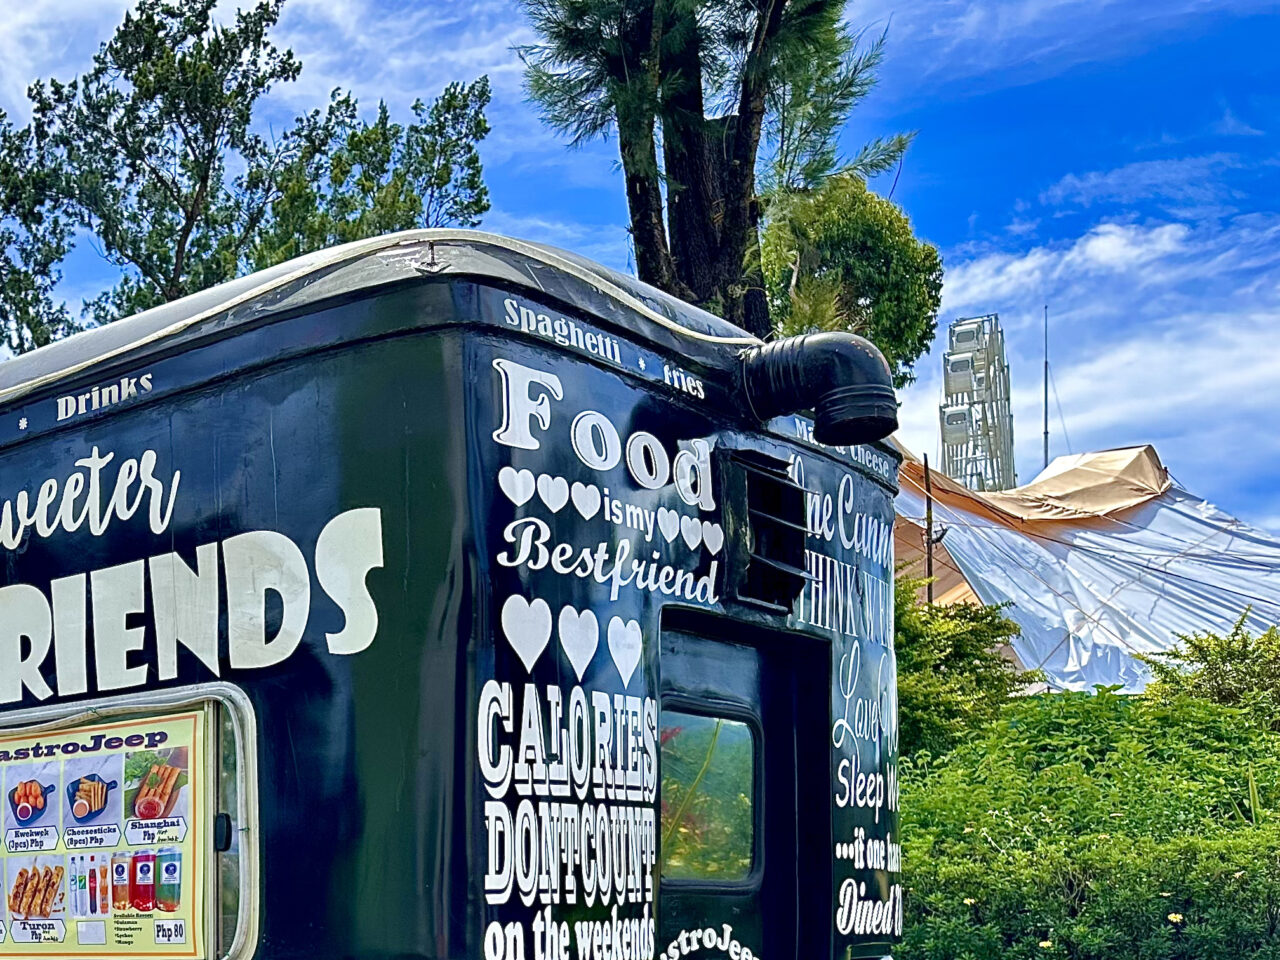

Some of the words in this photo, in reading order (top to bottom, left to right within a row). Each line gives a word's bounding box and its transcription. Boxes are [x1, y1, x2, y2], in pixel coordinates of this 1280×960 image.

[503, 297, 622, 364] Spaghetti
[56, 371, 154, 423] Drinks
[491, 357, 717, 513] Food
[603, 488, 623, 524] is
[626, 498, 656, 542] my
[496, 516, 720, 605] Bestfriend
[798, 549, 859, 638] THINK
[477, 679, 658, 804] CALORIES
[835, 755, 884, 824] Sleep
[29, 838, 44, 850] Php
[66, 827, 117, 837] Cheesesticks
[89, 836, 105, 846] Php
[130, 819, 181, 831] Shanghai
[142, 830, 156, 845] Php
[580, 802, 656, 908] COUNT
[866, 836, 886, 871] one
[19, 921, 56, 931] Turon
[155, 923, 174, 942] Php
[173, 923, 184, 938] 80
[836, 877, 895, 936] Dined
[30, 930, 43, 942] Php
